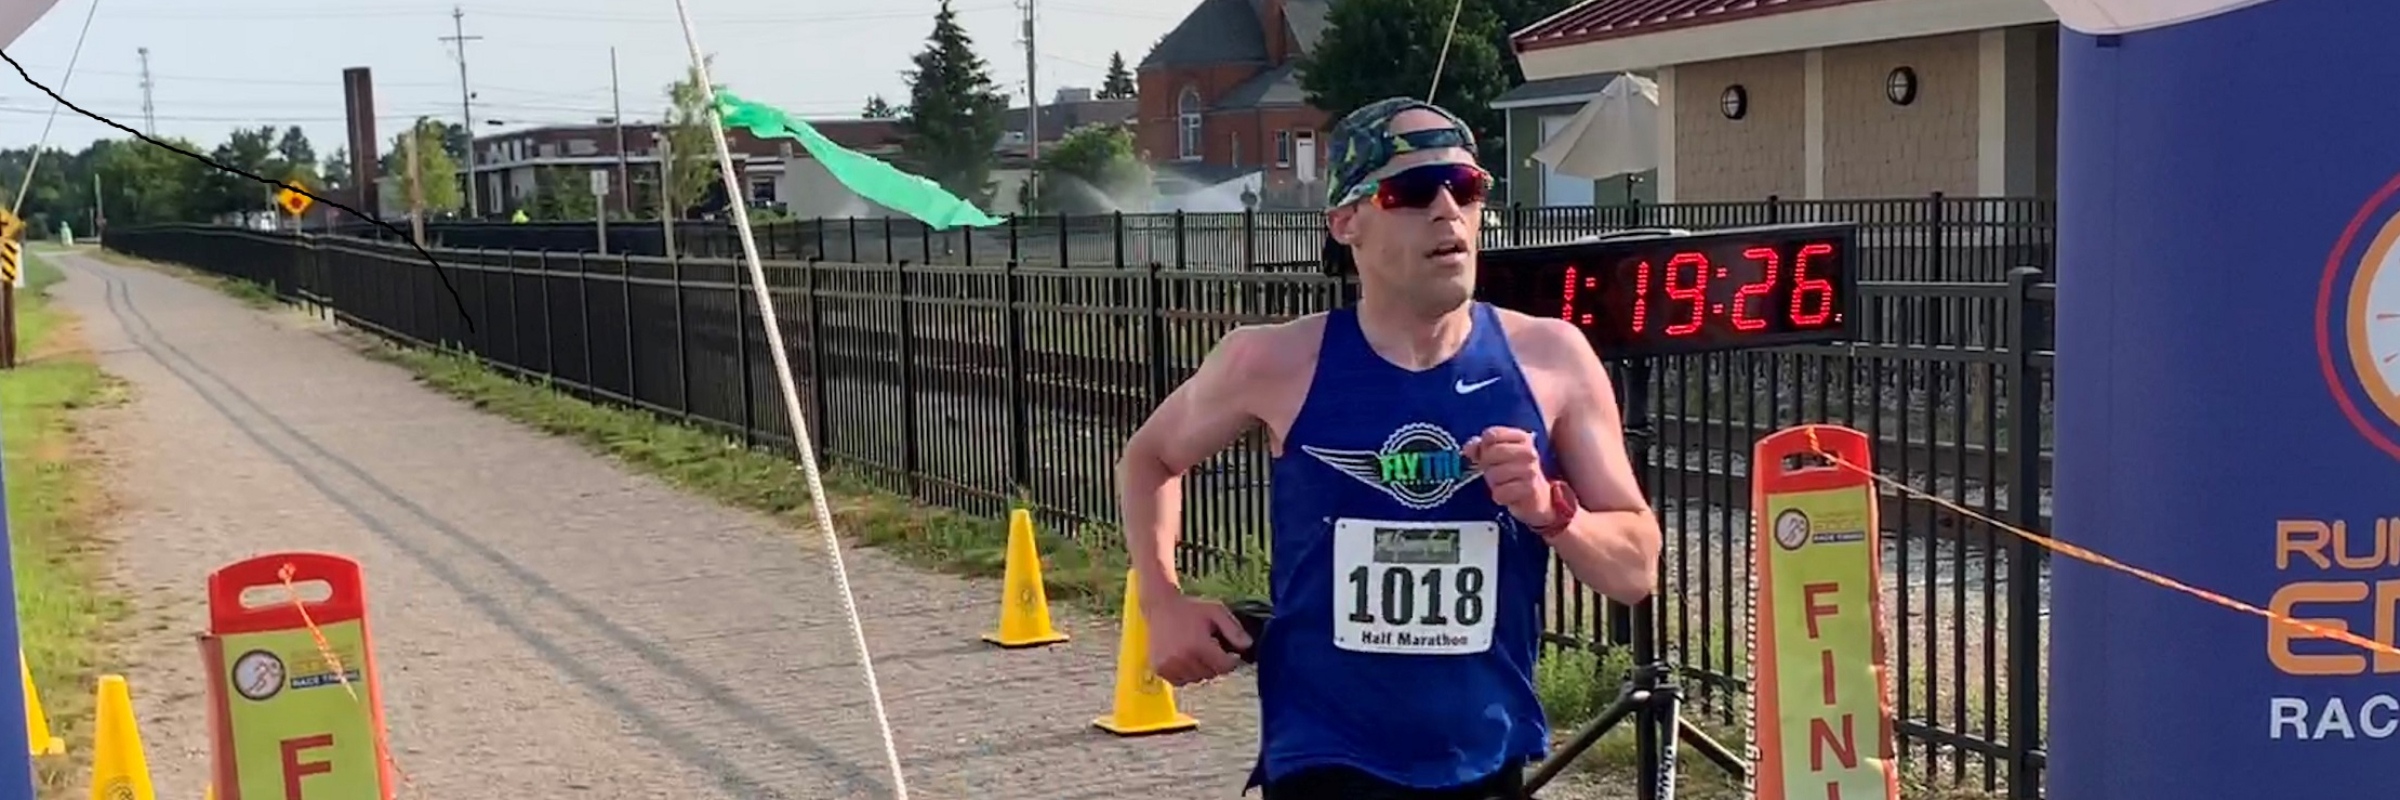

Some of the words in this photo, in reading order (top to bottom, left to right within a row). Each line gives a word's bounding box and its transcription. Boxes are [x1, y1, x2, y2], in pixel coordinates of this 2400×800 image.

[1562, 243, 1833, 336] 1:19:26
[1349, 565, 1484, 626] 1018
[2267, 581, 2400, 675] E
[1362, 631, 1392, 645] Half
[1397, 632, 1469, 647] Marathon
